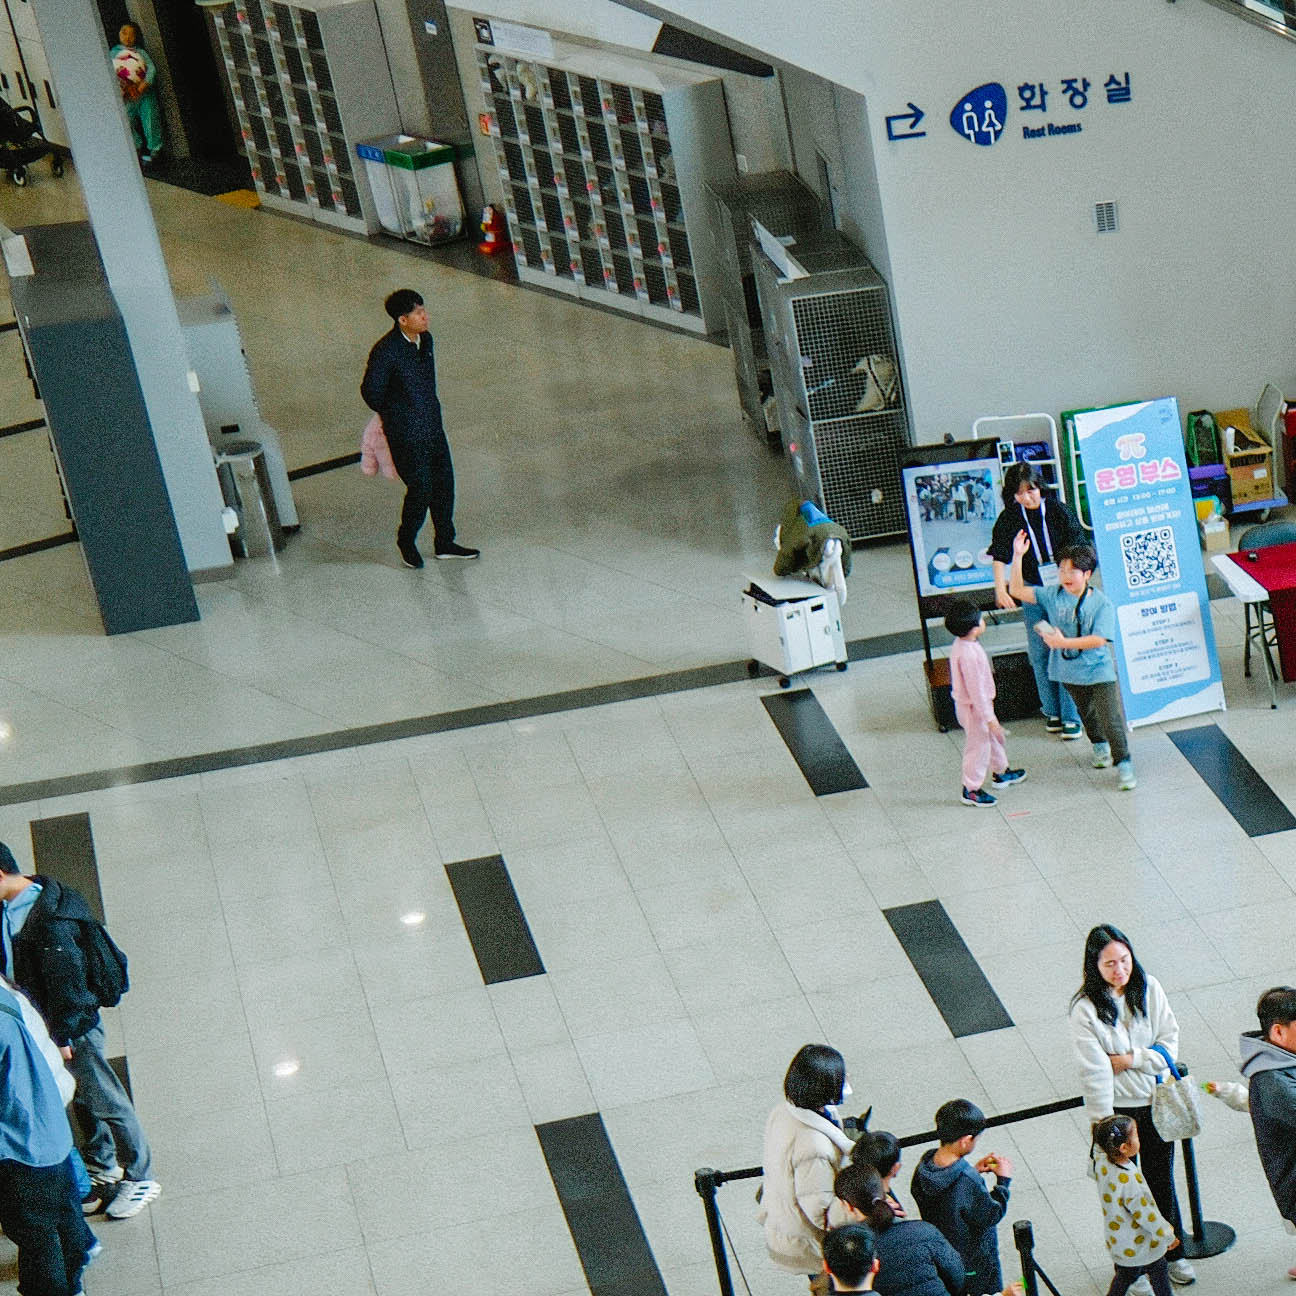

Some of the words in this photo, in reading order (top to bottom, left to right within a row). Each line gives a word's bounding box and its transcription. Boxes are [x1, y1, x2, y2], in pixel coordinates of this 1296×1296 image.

[1017, 72, 1132, 113] 화장실
[1023, 125, 1045, 139] Rest
[1048, 122, 1082, 136] Rooms
[1096, 465, 1136, 492] 운영
[1139, 458, 1181, 484] 부스
